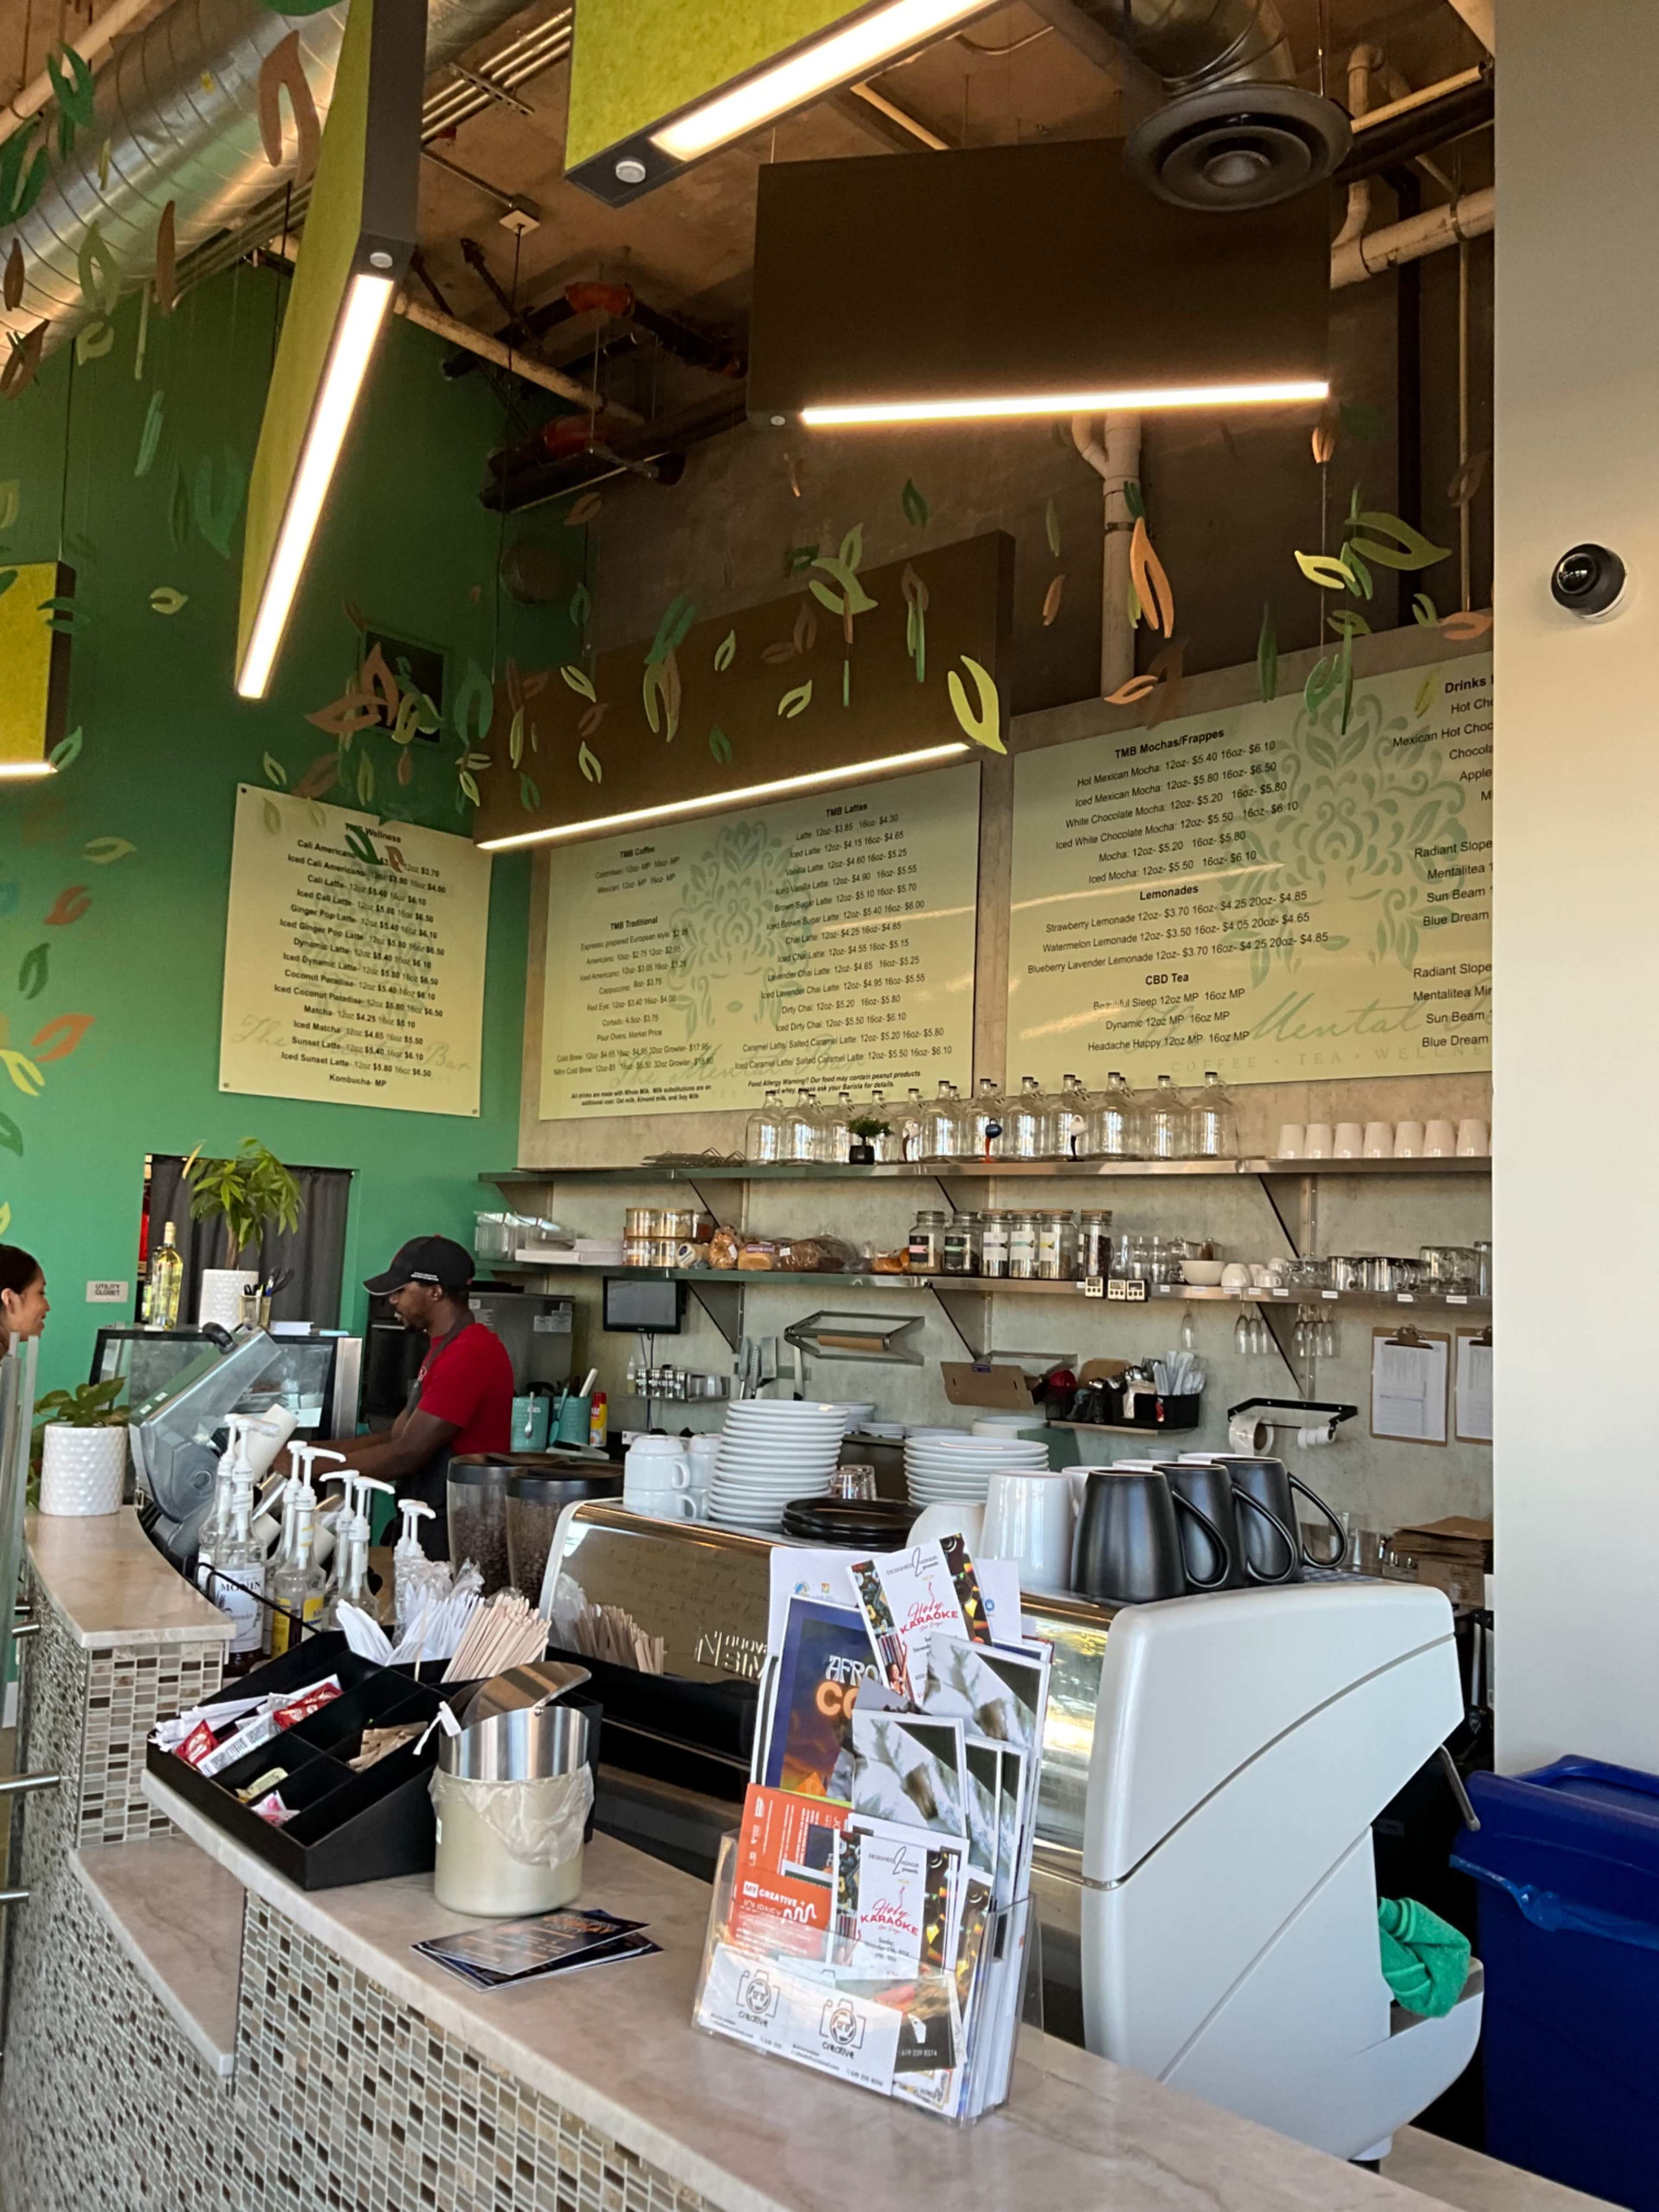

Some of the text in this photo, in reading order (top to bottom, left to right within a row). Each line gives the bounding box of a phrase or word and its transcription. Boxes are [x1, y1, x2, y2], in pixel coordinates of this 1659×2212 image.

[1445, 677, 1486, 693] Drinks
[1451, 702, 1470, 714] Hot
[1115, 731, 1224, 758] TMB Mochas/Frappes
[1393, 732, 1437, 747] Mexican
[1441, 727, 1460, 739] Hot
[1077, 777, 1092, 787] Hot
[1093, 771, 1129, 783] Mexican
[1166, 760, 1190, 770] 12oz-
[1192, 752, 1217, 765] $5.40
[1221, 749, 1246, 759] 16oz-
[1249, 741, 1275, 754] $6.10
[1459, 768, 1491, 782] Apple
[1075, 797, 1093, 807] Iced
[1095, 791, 1130, 803] Mexican
[1166, 780, 1191, 790] 12oz-
[1193, 772, 1219, 785] $5.80
[1222, 769, 1248, 779] 16oz-
[1250, 762, 1277, 775] $6.50
[826, 804, 868, 817] TMB Lattes
[1065, 818, 1089, 828] White
[1091, 810, 1133, 823] Chocolate
[1170, 800, 1195, 810] 12oz-
[1197, 792, 1223, 805] $5.20
[1232, 788, 1258, 798] 16oz-
[1260, 782, 1287, 795] $5.80
[620, 846, 655, 858] TMB Coffee
[1414, 844, 1456, 858] Radiant
[1427, 864, 1485, 879] Mentalitea
[1140, 886, 1198, 900] Lemonades
[1427, 888, 1485, 903] Sun Beam
[1046, 890, 1307, 933] Strawberry Lemonade 12oz- $3.70 16oz- $4.25 20oz- $4.85
[1423, 911, 1489, 926] Blue Dream
[610, 917, 658, 930] TMB Traditional
[1042, 912, 1310, 952] Watermelon Lemonade 12oz- $3.50 16oz- $4.05 20oz- $4.65
[1145, 973, 1189, 985] CBD Tea
[1414, 966, 1456, 978] Radiant
[1413, 988, 1470, 1001] Mentalitea
[1106, 1011, 1230, 1031] Dynamic 12oz MP 16oz MP
[1426, 1011, 1484, 1023] Sun Beam
[1088, 1030, 1250, 1051] Headache Happy 12oz MP 16oz MP
[1422, 1036, 1488, 1047] Blue Dream
[1171, 1056, 1257, 1073] COFFEE
[1299, 1052, 1341, 1065] TEA
[899, 1611, 959, 1634] KARAOKE
[746, 1884, 798, 1907] MY CREATIVE
[861, 1914, 919, 1936] KARAOKE
